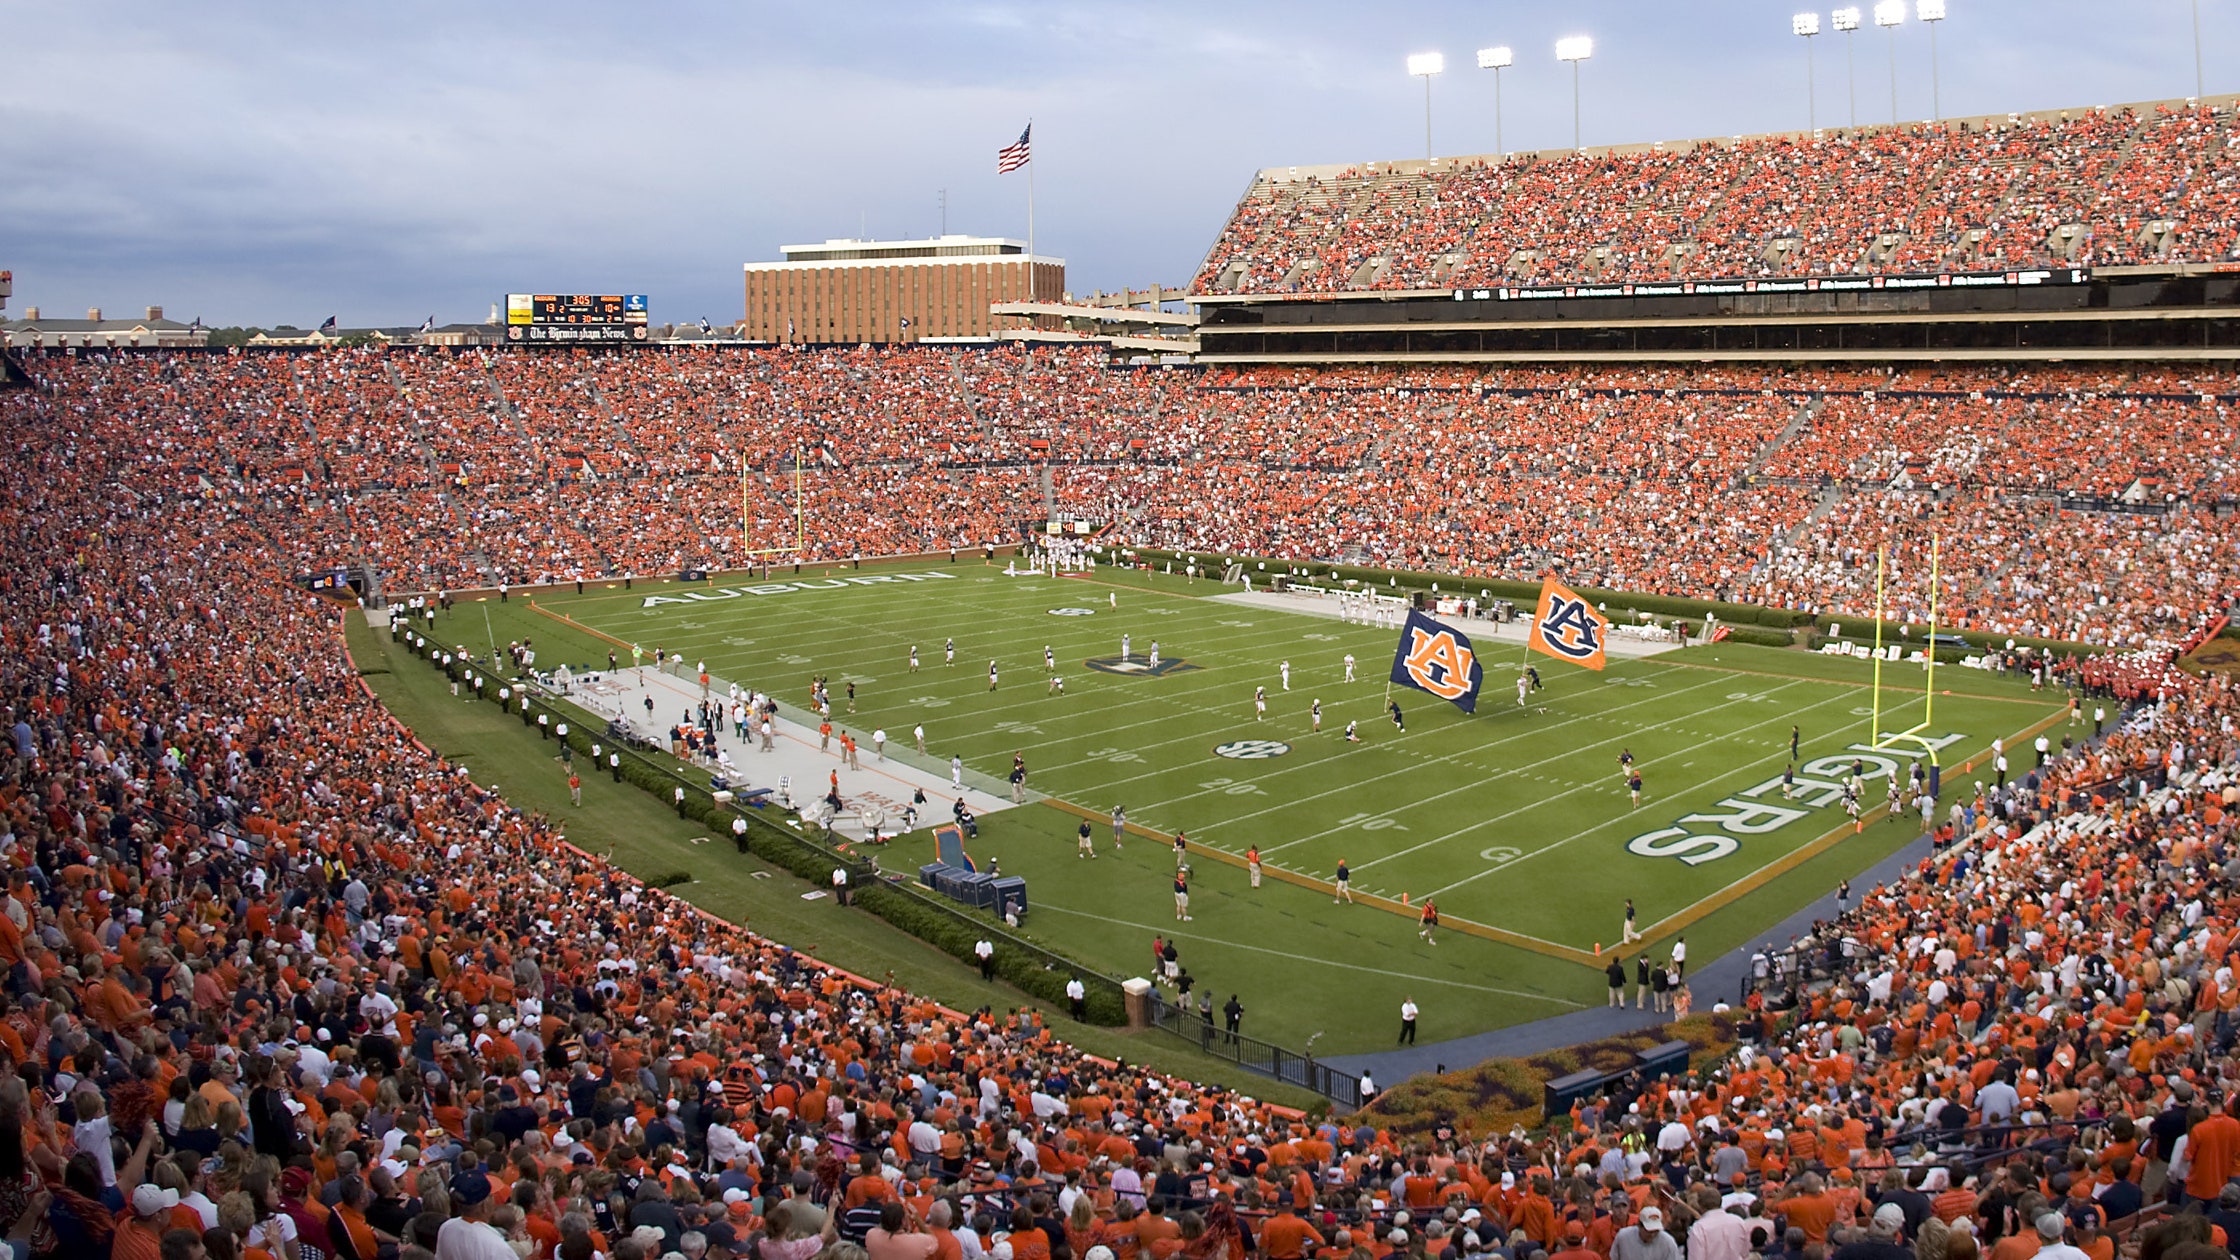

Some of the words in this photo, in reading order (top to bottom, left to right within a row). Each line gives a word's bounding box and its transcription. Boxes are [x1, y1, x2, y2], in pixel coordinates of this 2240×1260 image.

[546, 303, 555, 313] 13
[530, 327, 546, 339] The
[548, 326, 601, 341] Birmingham
[641, 571, 957, 608] AUBURN
[1086, 747, 1140, 763] 30
[1198, 777, 1258, 796] 20
[1627, 730, 1970, 867] TIGERS
[1338, 812, 1397, 832] 10
[1480, 845, 1523, 863] G
